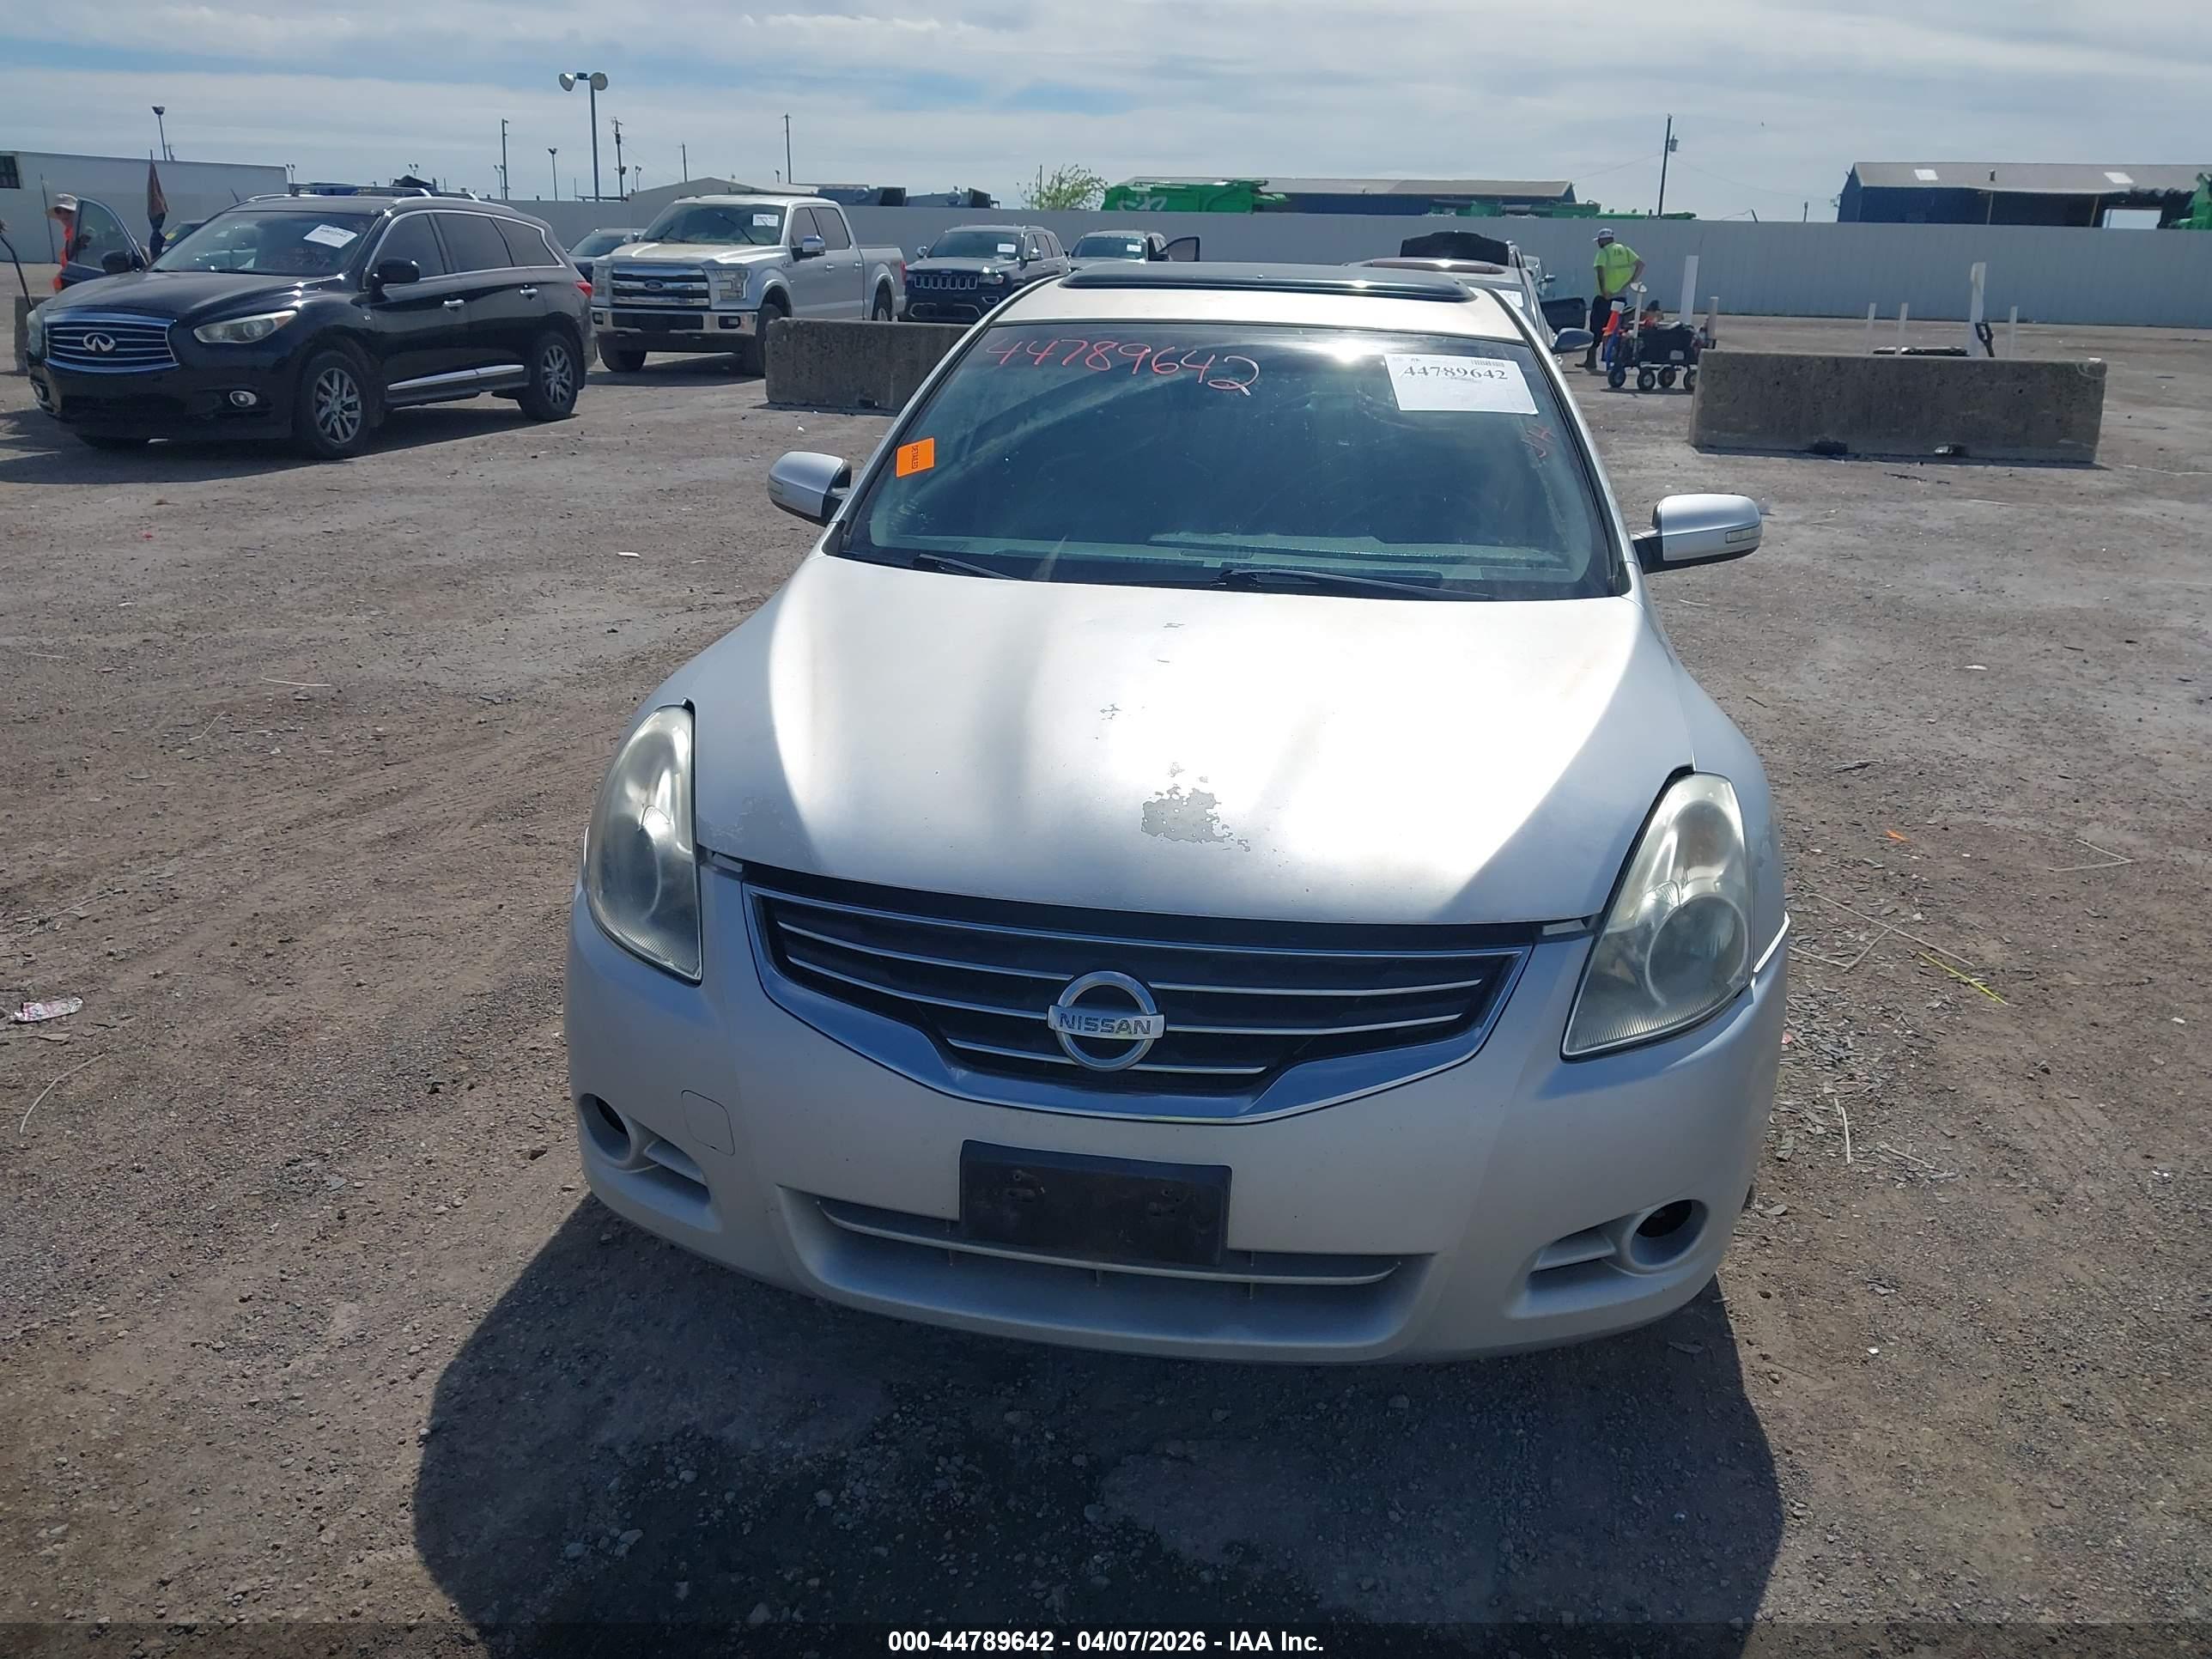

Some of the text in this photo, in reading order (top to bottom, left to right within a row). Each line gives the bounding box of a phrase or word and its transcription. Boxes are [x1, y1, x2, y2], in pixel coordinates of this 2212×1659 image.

[987, 339, 1260, 396] 44789642
[1404, 365, 1509, 380] 44789642
[1059, 1012, 1152, 1035] NISSAN
